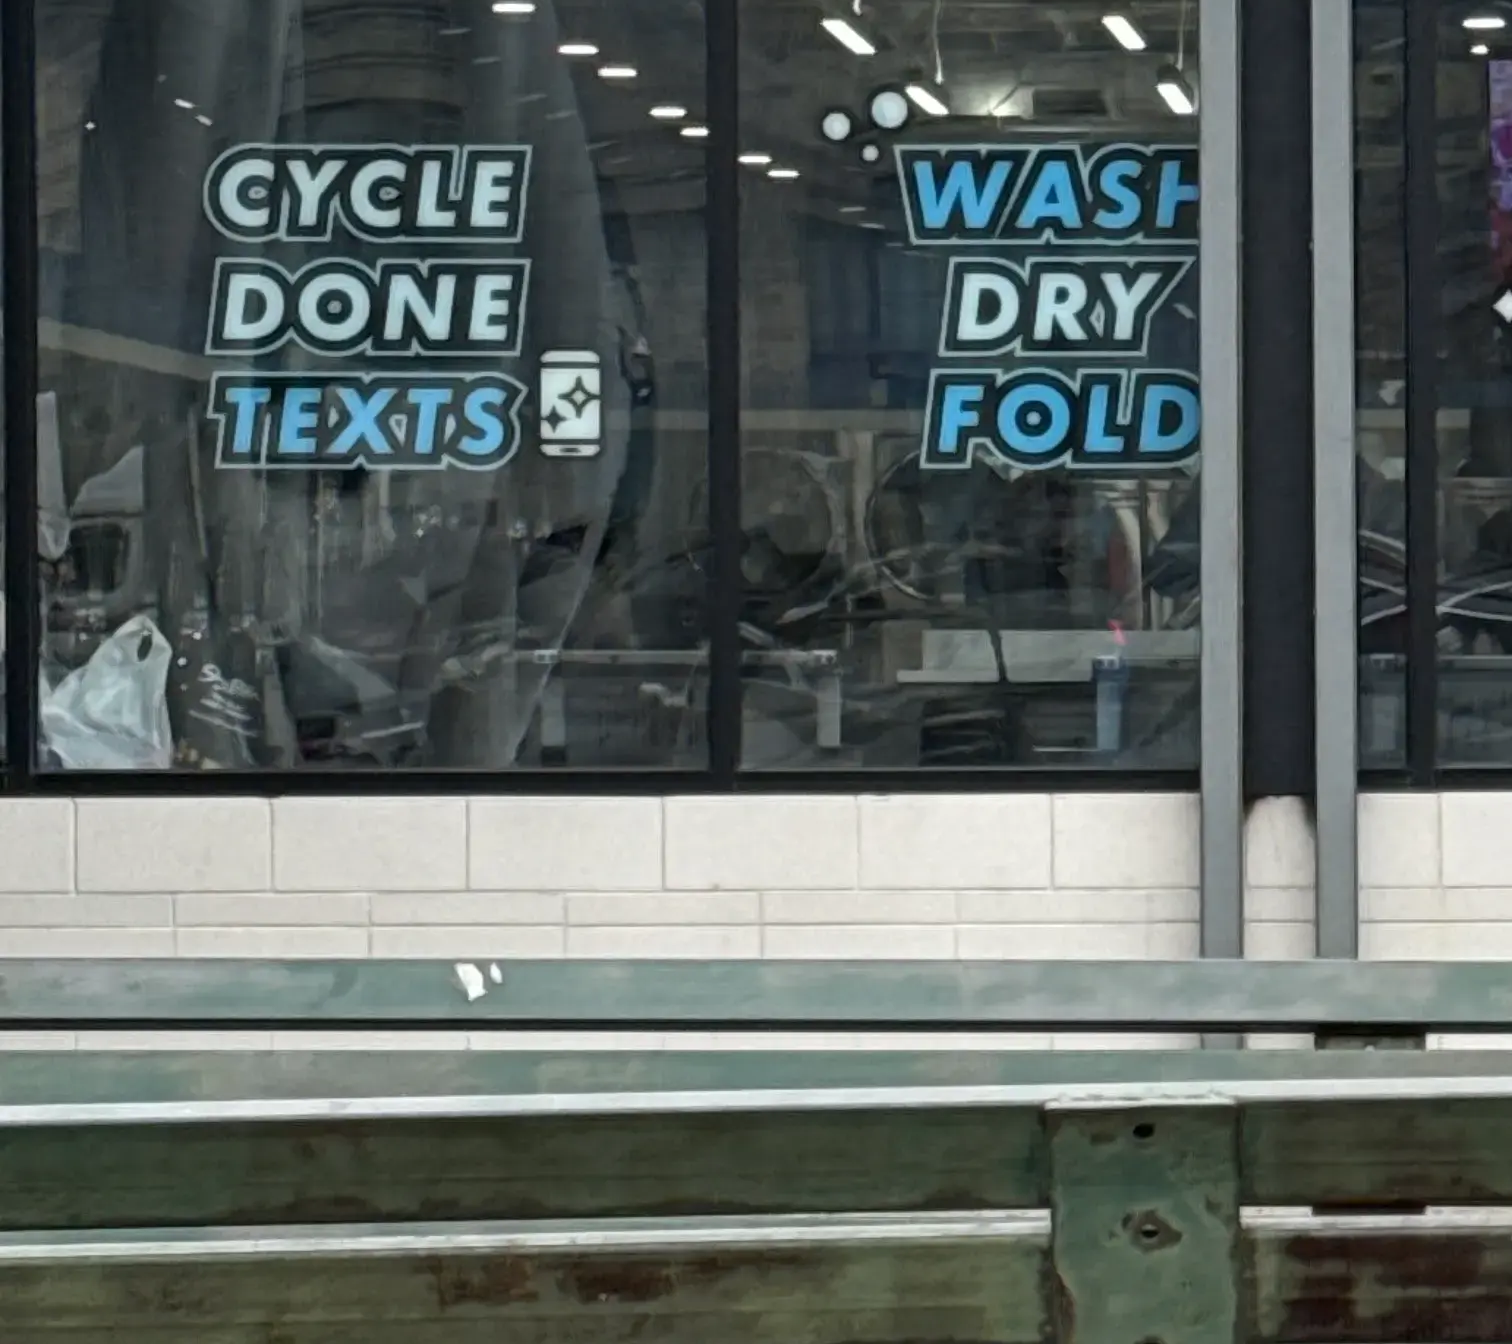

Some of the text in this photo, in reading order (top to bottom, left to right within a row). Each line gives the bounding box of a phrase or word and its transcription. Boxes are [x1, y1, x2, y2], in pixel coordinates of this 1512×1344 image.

[218, 158, 515, 228] CYCLE
[222, 272, 514, 341] DONE
[956, 271, 1163, 341] DRY
[224, 386, 507, 455] TEXTS
[937, 382, 1200, 454] FOLD
